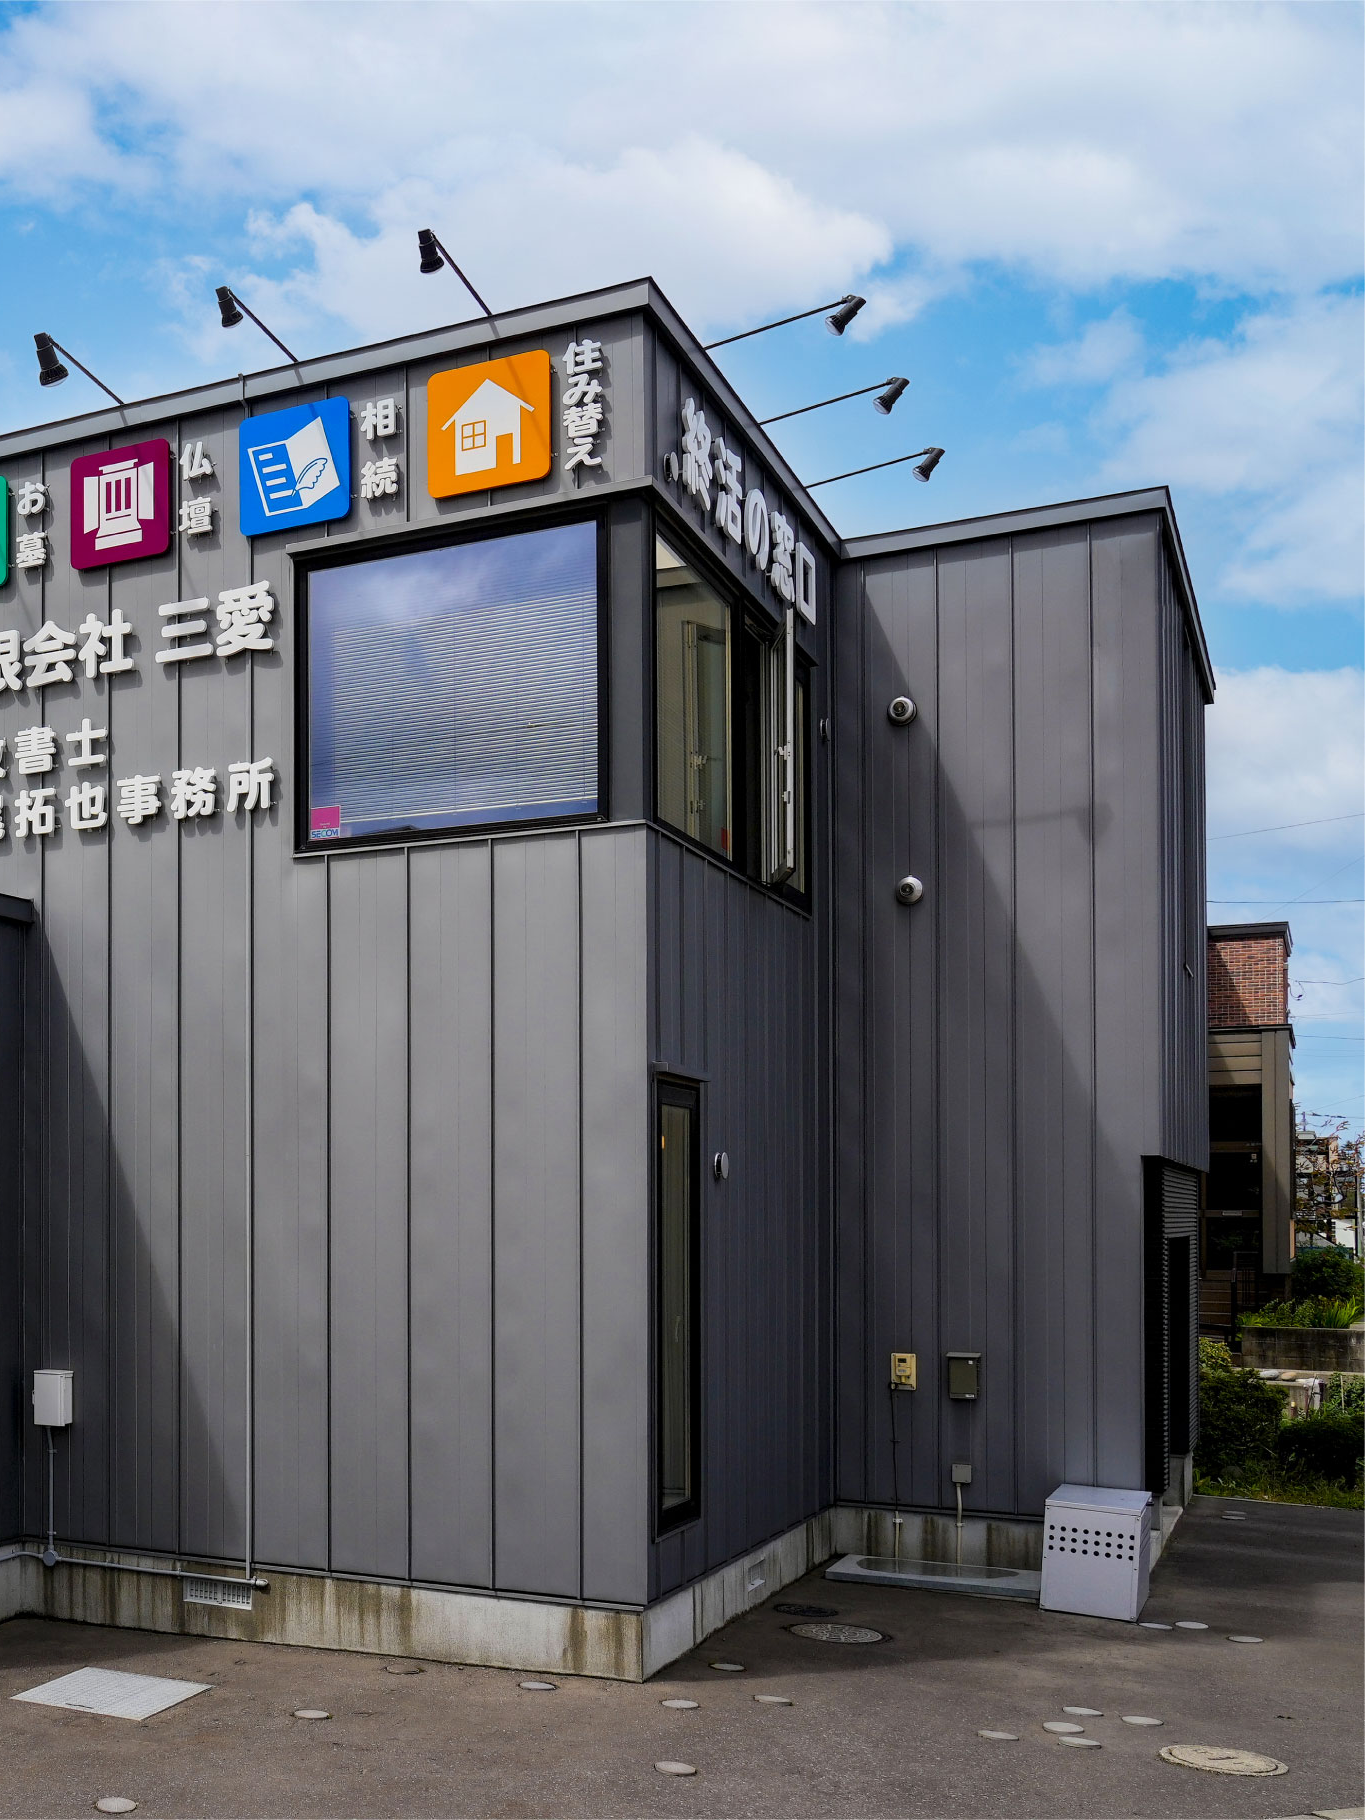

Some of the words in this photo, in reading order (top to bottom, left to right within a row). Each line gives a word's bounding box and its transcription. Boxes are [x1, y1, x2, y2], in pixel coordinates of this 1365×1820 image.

[360, 398, 398, 499] 相続
[562, 339, 603, 471] 住み替え
[16, 481, 48, 569] お墓
[178, 441, 214, 535] 仏壇
[682, 397, 817, 626] 終活の窓口
[155, 580, 275, 663] 三愛
[311, 829, 339, 838] SECOM
